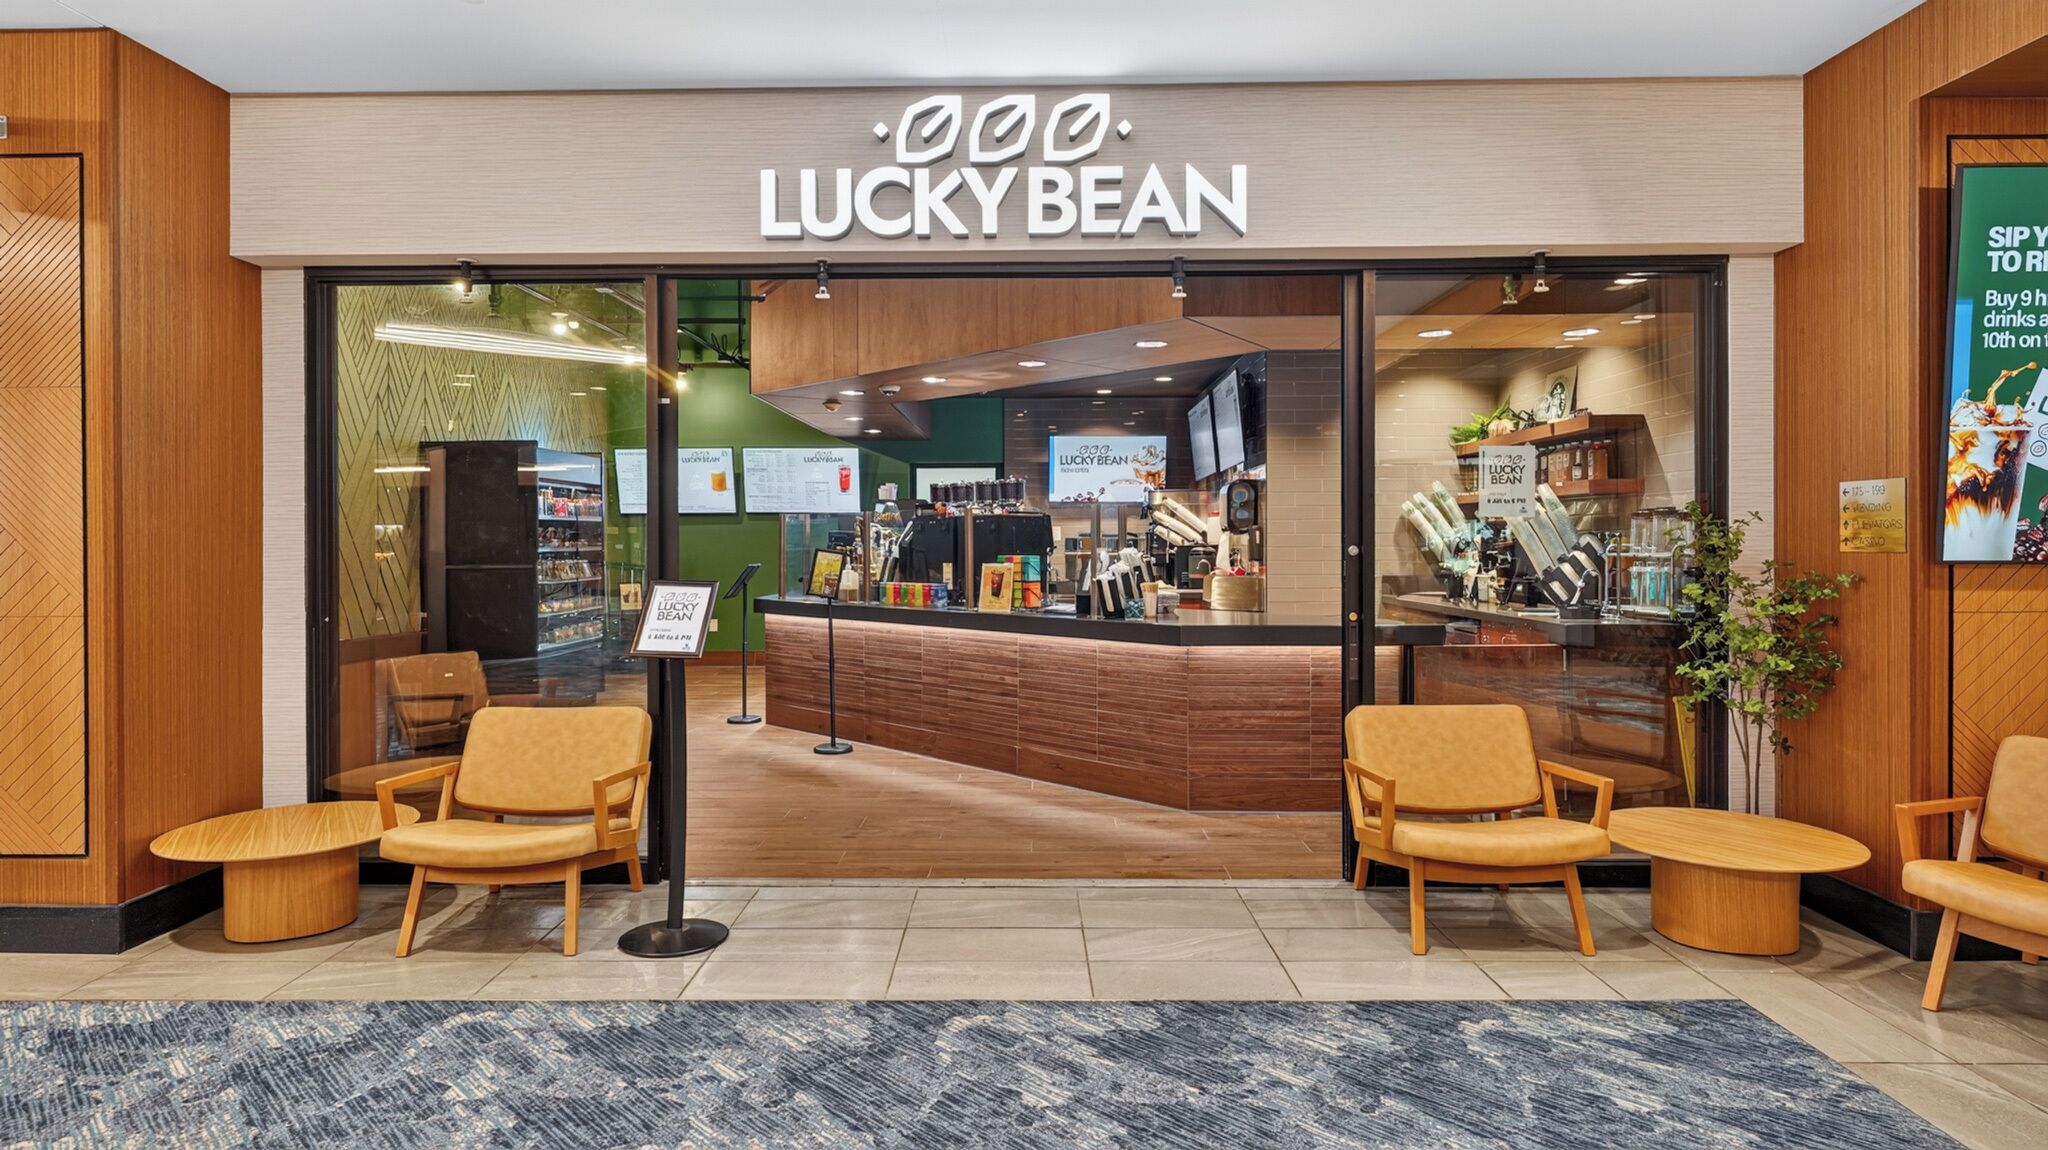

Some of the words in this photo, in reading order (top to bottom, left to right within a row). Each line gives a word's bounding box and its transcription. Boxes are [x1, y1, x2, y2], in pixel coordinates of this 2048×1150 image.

[760, 166, 1018, 240] LUCKY
[1027, 163, 1248, 239] BEAN
[1988, 226, 2031, 248] SIP
[1987, 250, 2022, 272] TO
[1985, 289, 2018, 311] Buy
[2020, 289, 2032, 307] 9
[1983, 309, 2036, 328] drinks
[1982, 331, 2016, 349] 10th
[2018, 334, 2041, 348] on
[1060, 455, 1095, 465] LUCKY
[1097, 455, 1128, 465] BEAN
[1489, 464, 1525, 474] LUCKY
[1491, 475, 1522, 484] BEAN
[657, 601, 699, 611] LUCKY
[657, 611, 693, 620] BEAN
